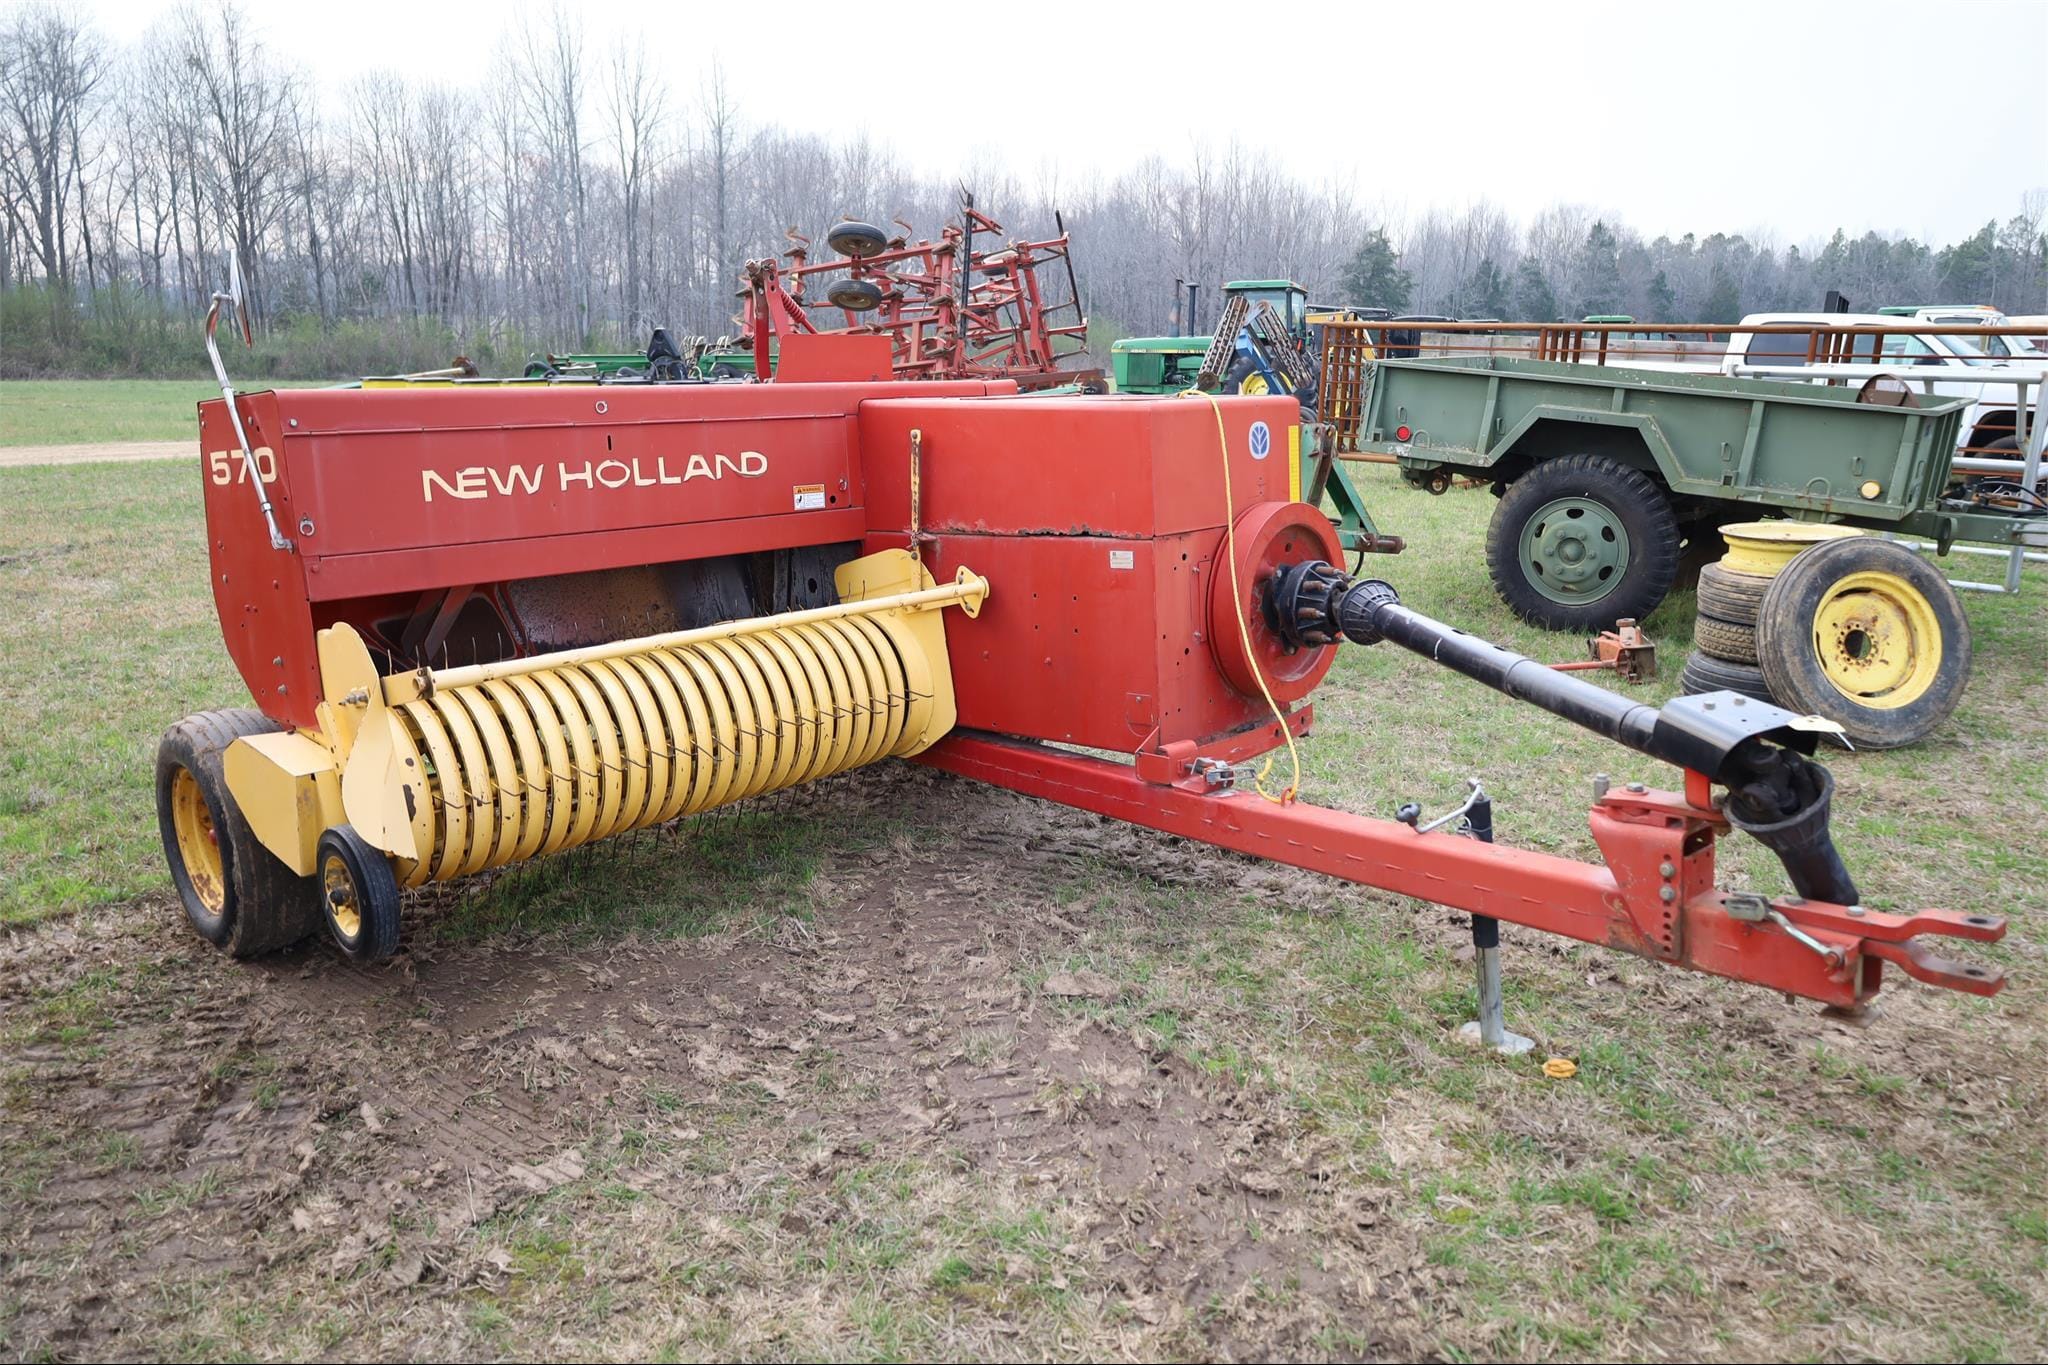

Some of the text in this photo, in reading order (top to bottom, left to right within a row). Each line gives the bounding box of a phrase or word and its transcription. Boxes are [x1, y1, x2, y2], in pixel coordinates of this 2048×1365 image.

[209, 446, 277, 485] 570
[422, 451, 769, 502] NEW HOLLAND
